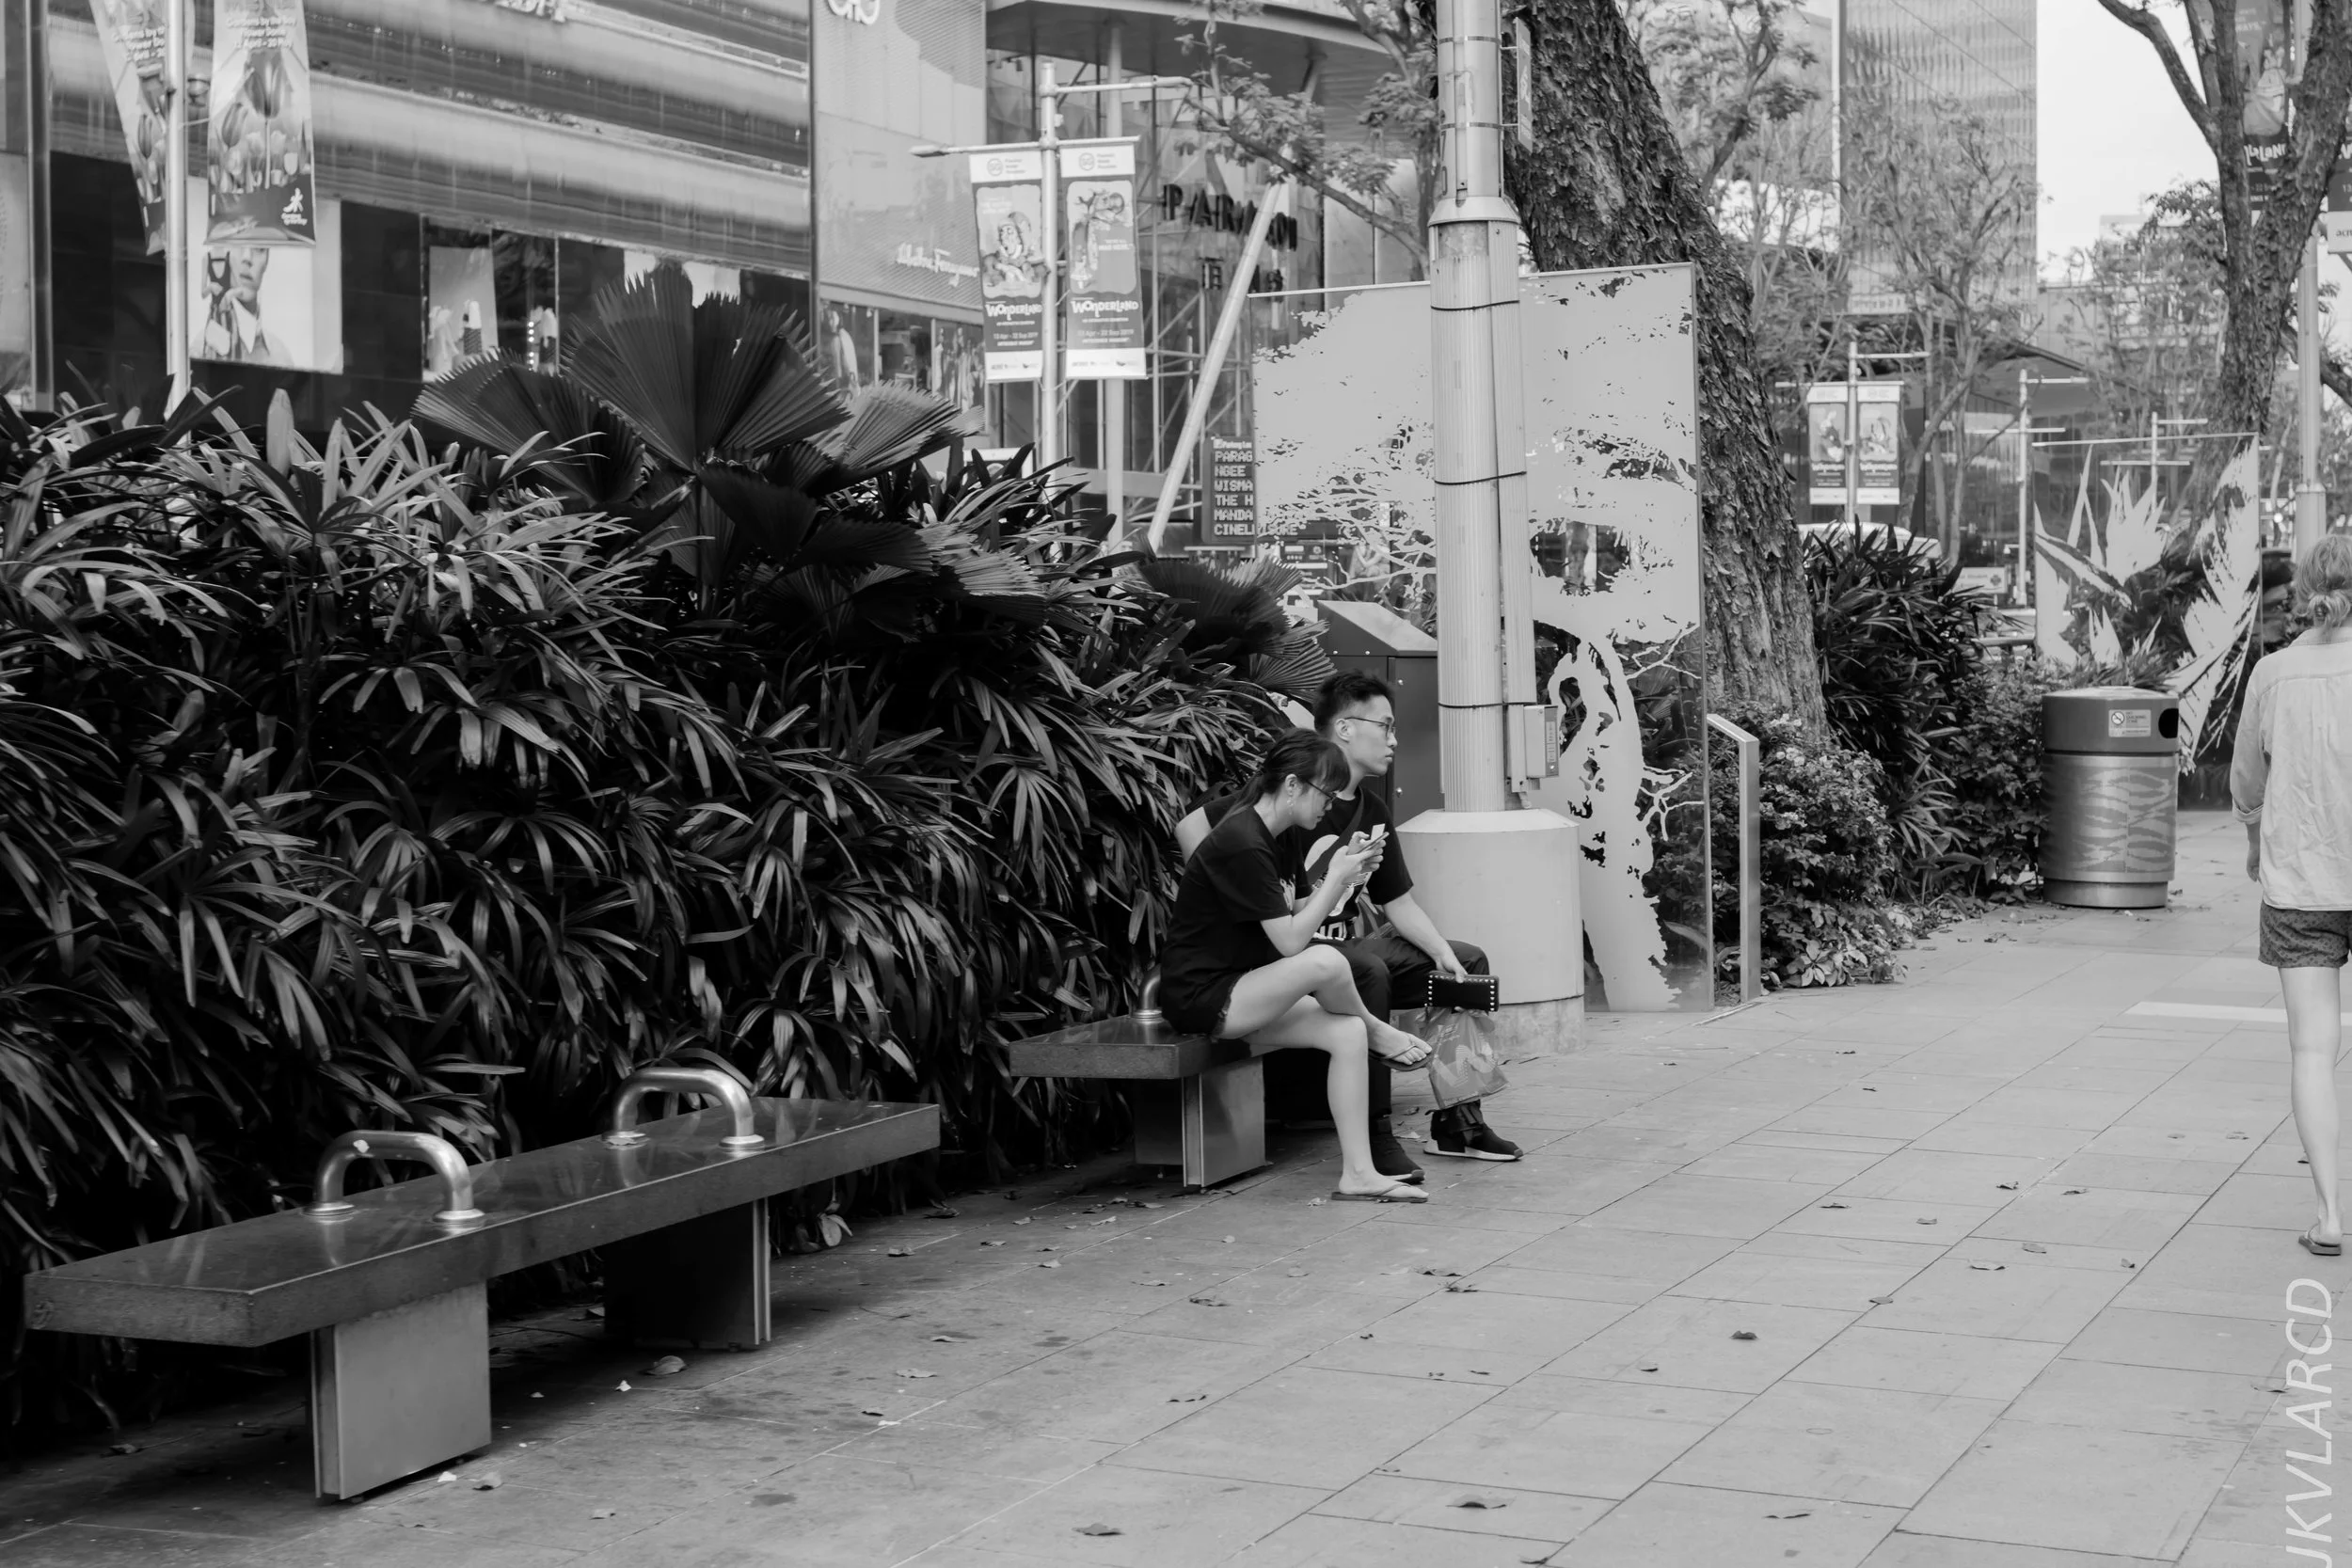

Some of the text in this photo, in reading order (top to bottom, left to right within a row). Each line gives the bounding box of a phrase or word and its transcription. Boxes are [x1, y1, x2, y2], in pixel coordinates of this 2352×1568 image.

[1163, 183, 1298, 252] PARAON
[1214, 480, 1253, 492] WISMA
[1214, 494, 1239, 506] THE
